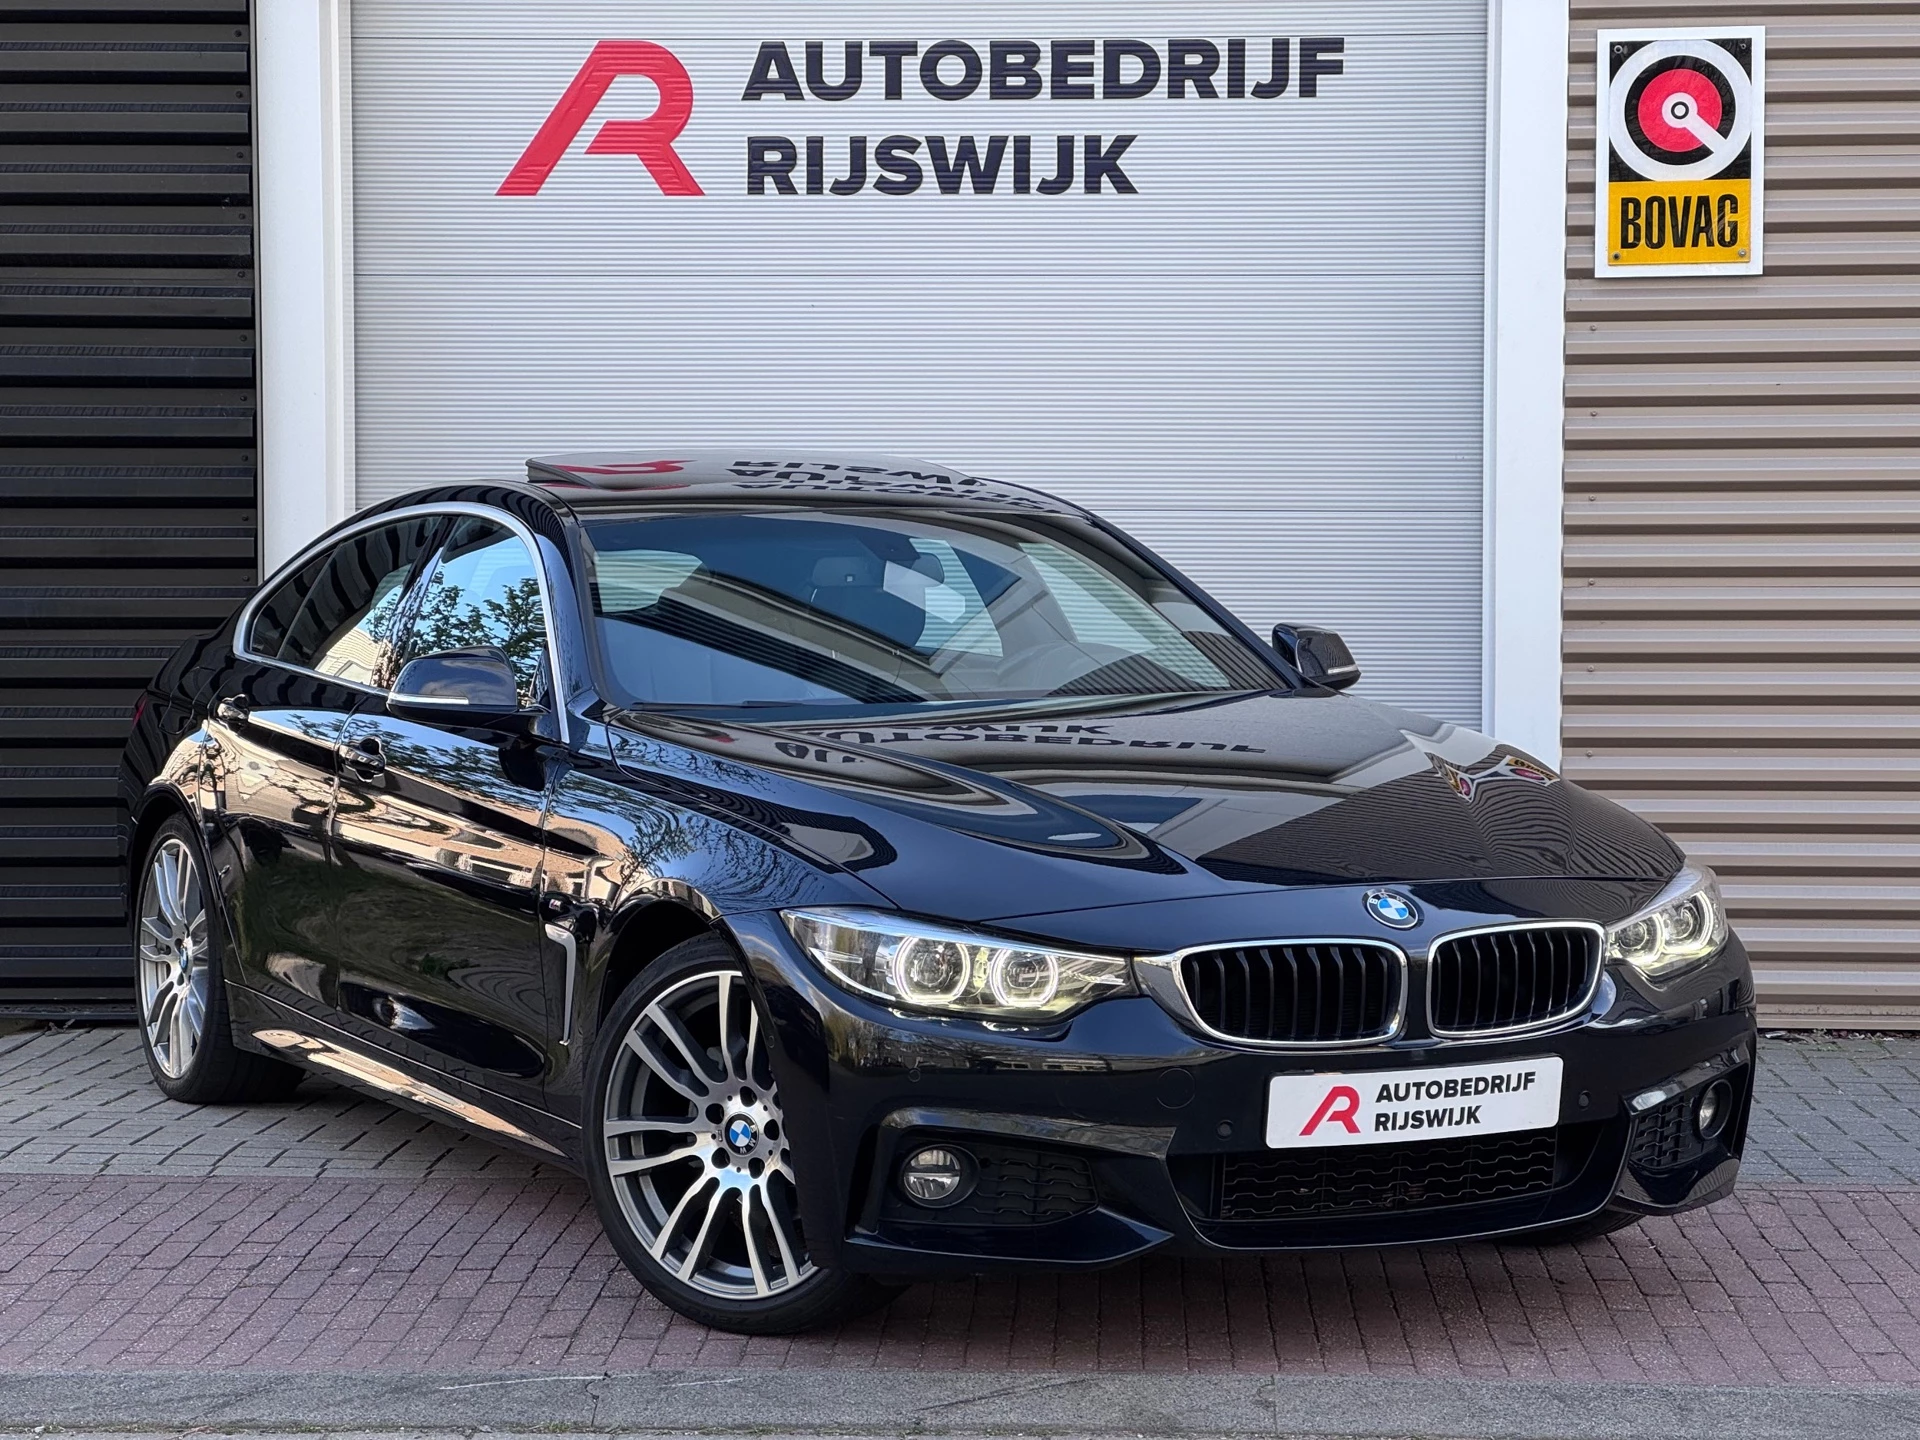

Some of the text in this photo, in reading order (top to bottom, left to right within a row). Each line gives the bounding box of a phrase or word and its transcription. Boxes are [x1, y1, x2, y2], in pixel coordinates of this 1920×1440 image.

[741, 37, 1345, 101] AUTOBEDRIJF
[747, 135, 1139, 195] RIJSWIJK
[1620, 193, 1739, 250] BOVAG
[1375, 1071, 1536, 1103] AUTOBEDRIJF
[1374, 1105, 1482, 1132] RIJSWIJK
